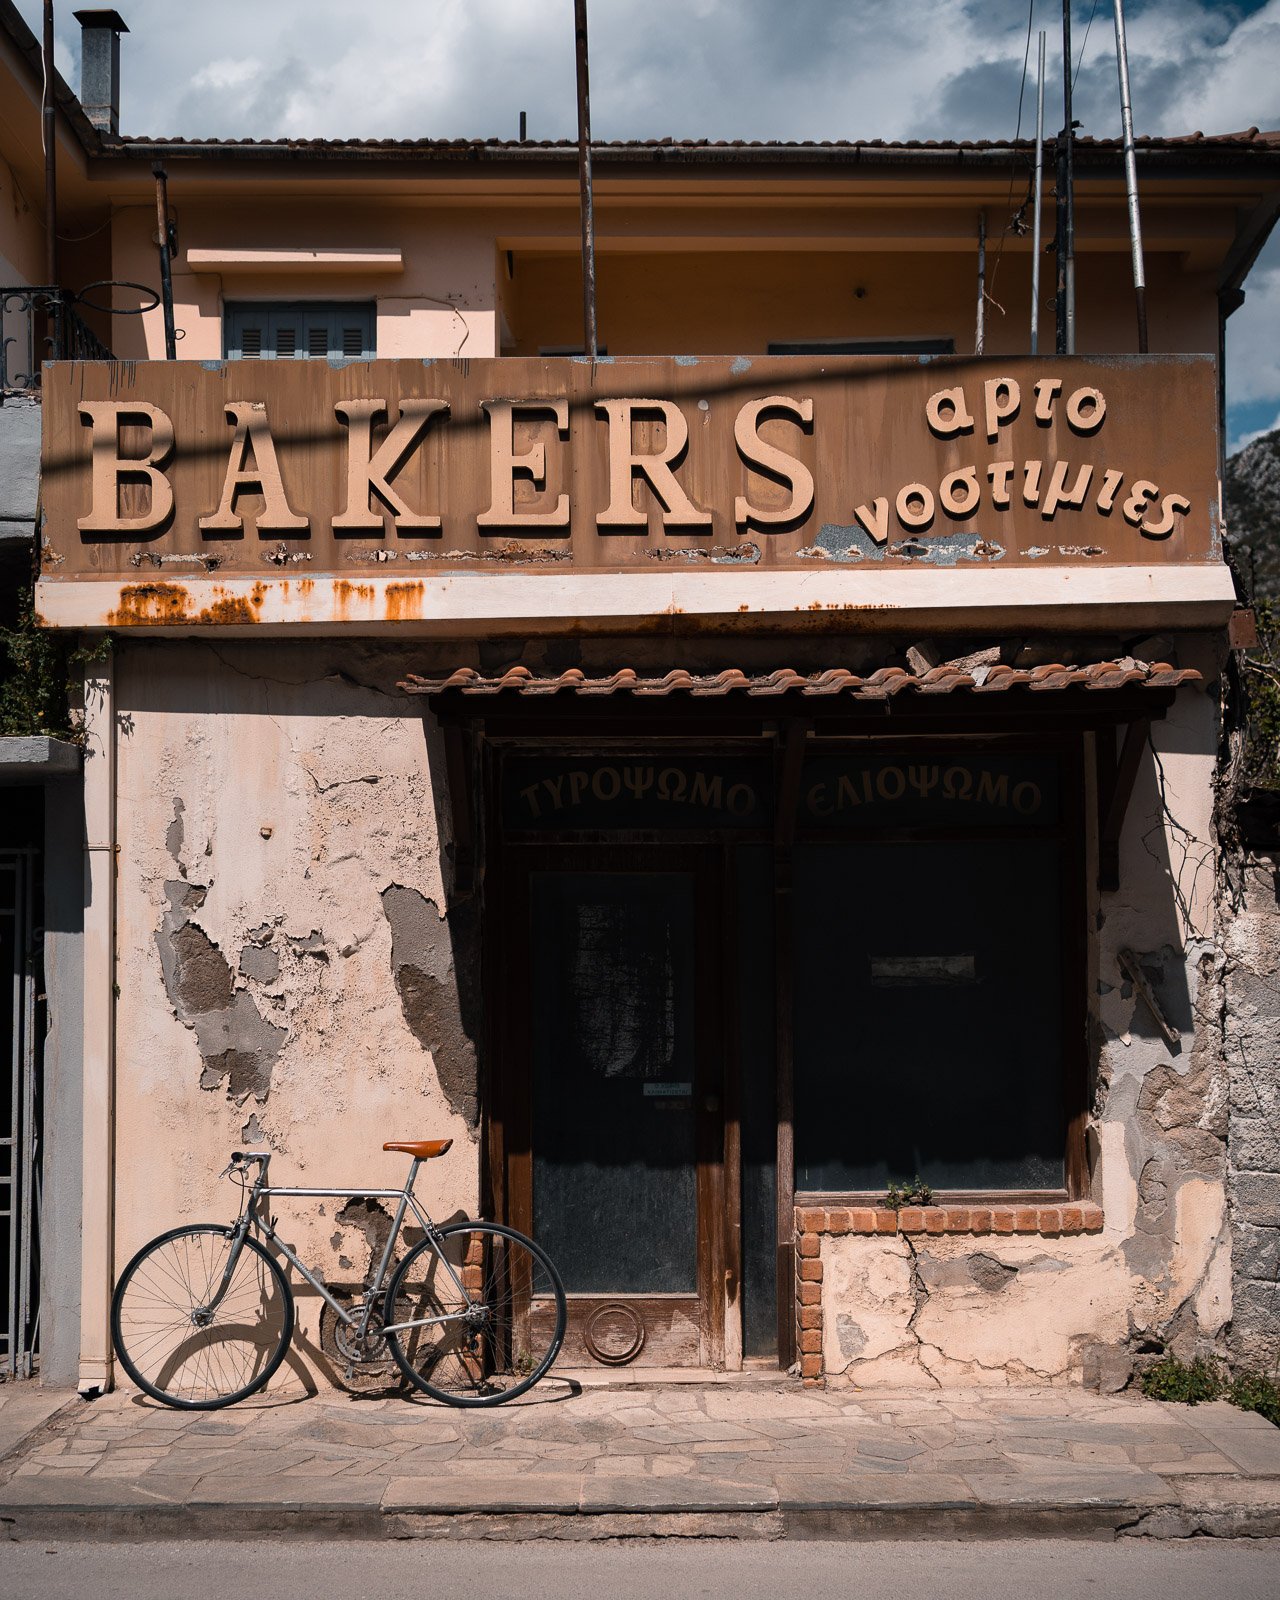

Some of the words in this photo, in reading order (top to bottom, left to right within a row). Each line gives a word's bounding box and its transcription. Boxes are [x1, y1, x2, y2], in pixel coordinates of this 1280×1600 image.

[925, 378, 1106, 437] αρτο
[77, 395, 815, 531] BAKERS
[854, 460, 1191, 543] νοστιμιες
[519, 766, 756, 817] ΤΥΡΟΨΩΜΟ
